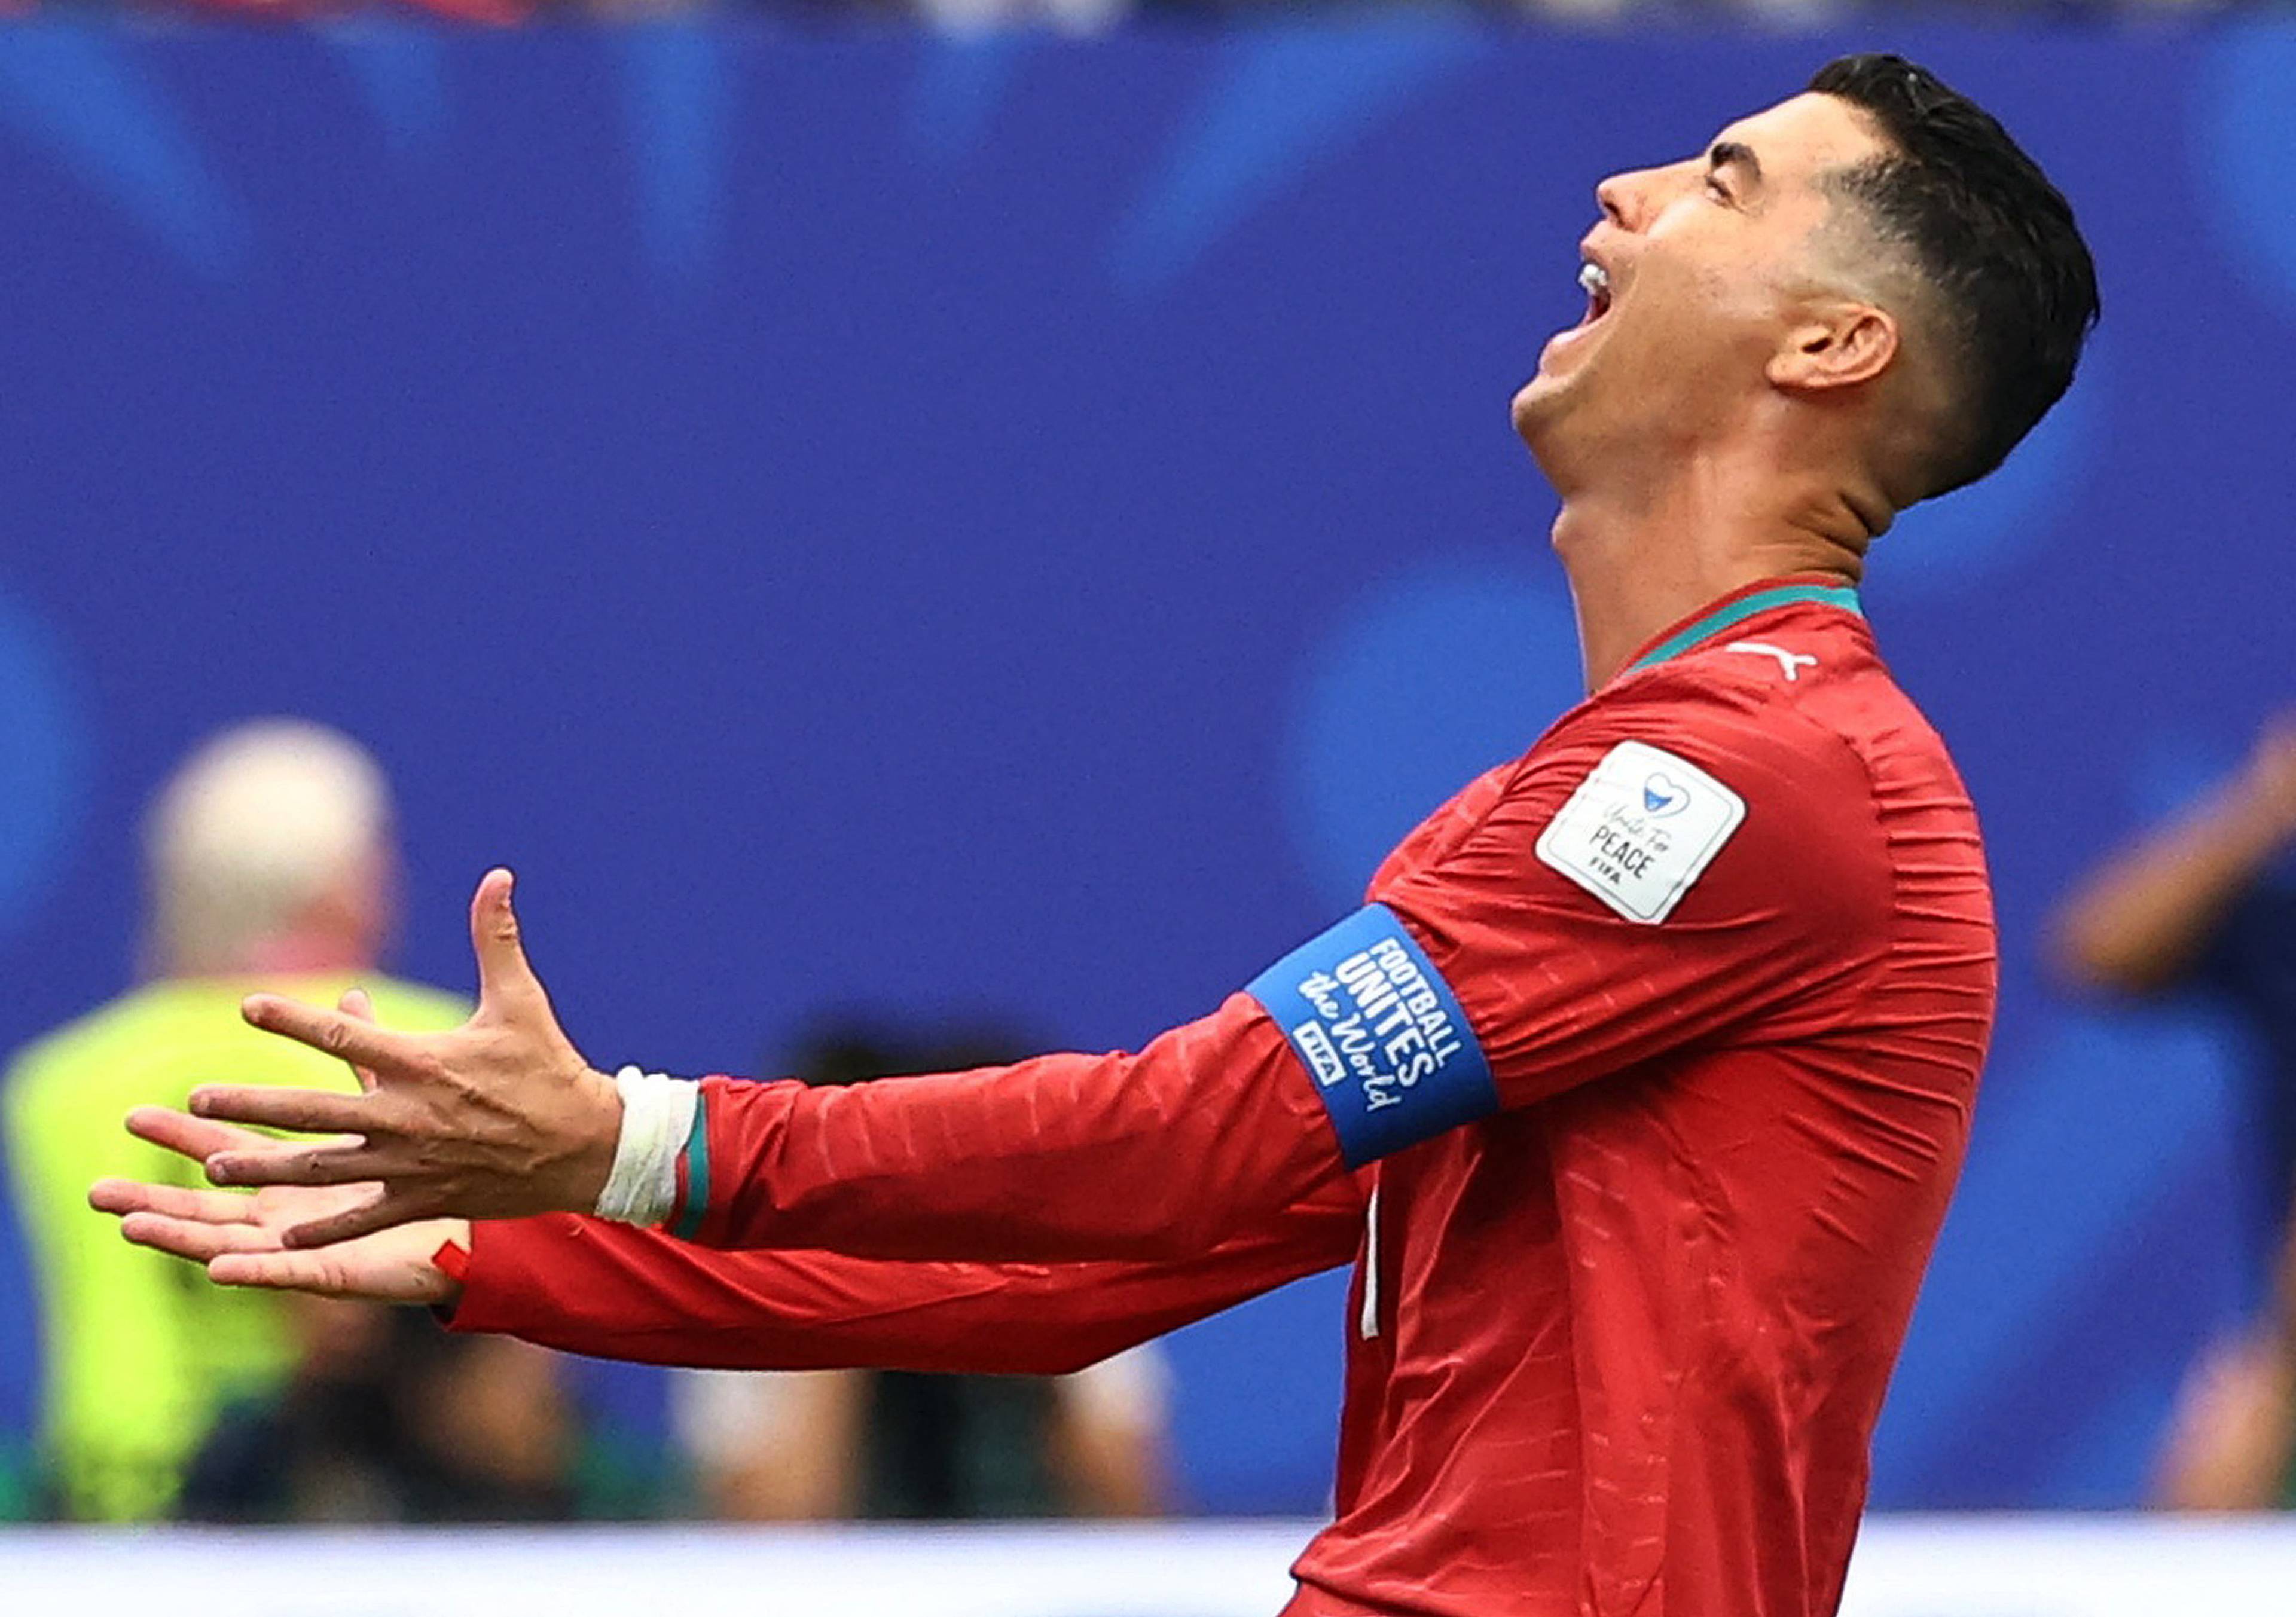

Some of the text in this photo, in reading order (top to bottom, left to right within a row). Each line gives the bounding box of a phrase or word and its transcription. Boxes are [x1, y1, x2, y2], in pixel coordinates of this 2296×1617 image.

[1589, 825, 1655, 879] PEACE
[1589, 856, 1621, 885] FIFA
[1299, 971, 1401, 1112] the World
[1335, 952, 1434, 1087] UNITES
[1369, 937, 1461, 1067] FOOTBALL
[1302, 1029, 1336, 1078] FIFA
